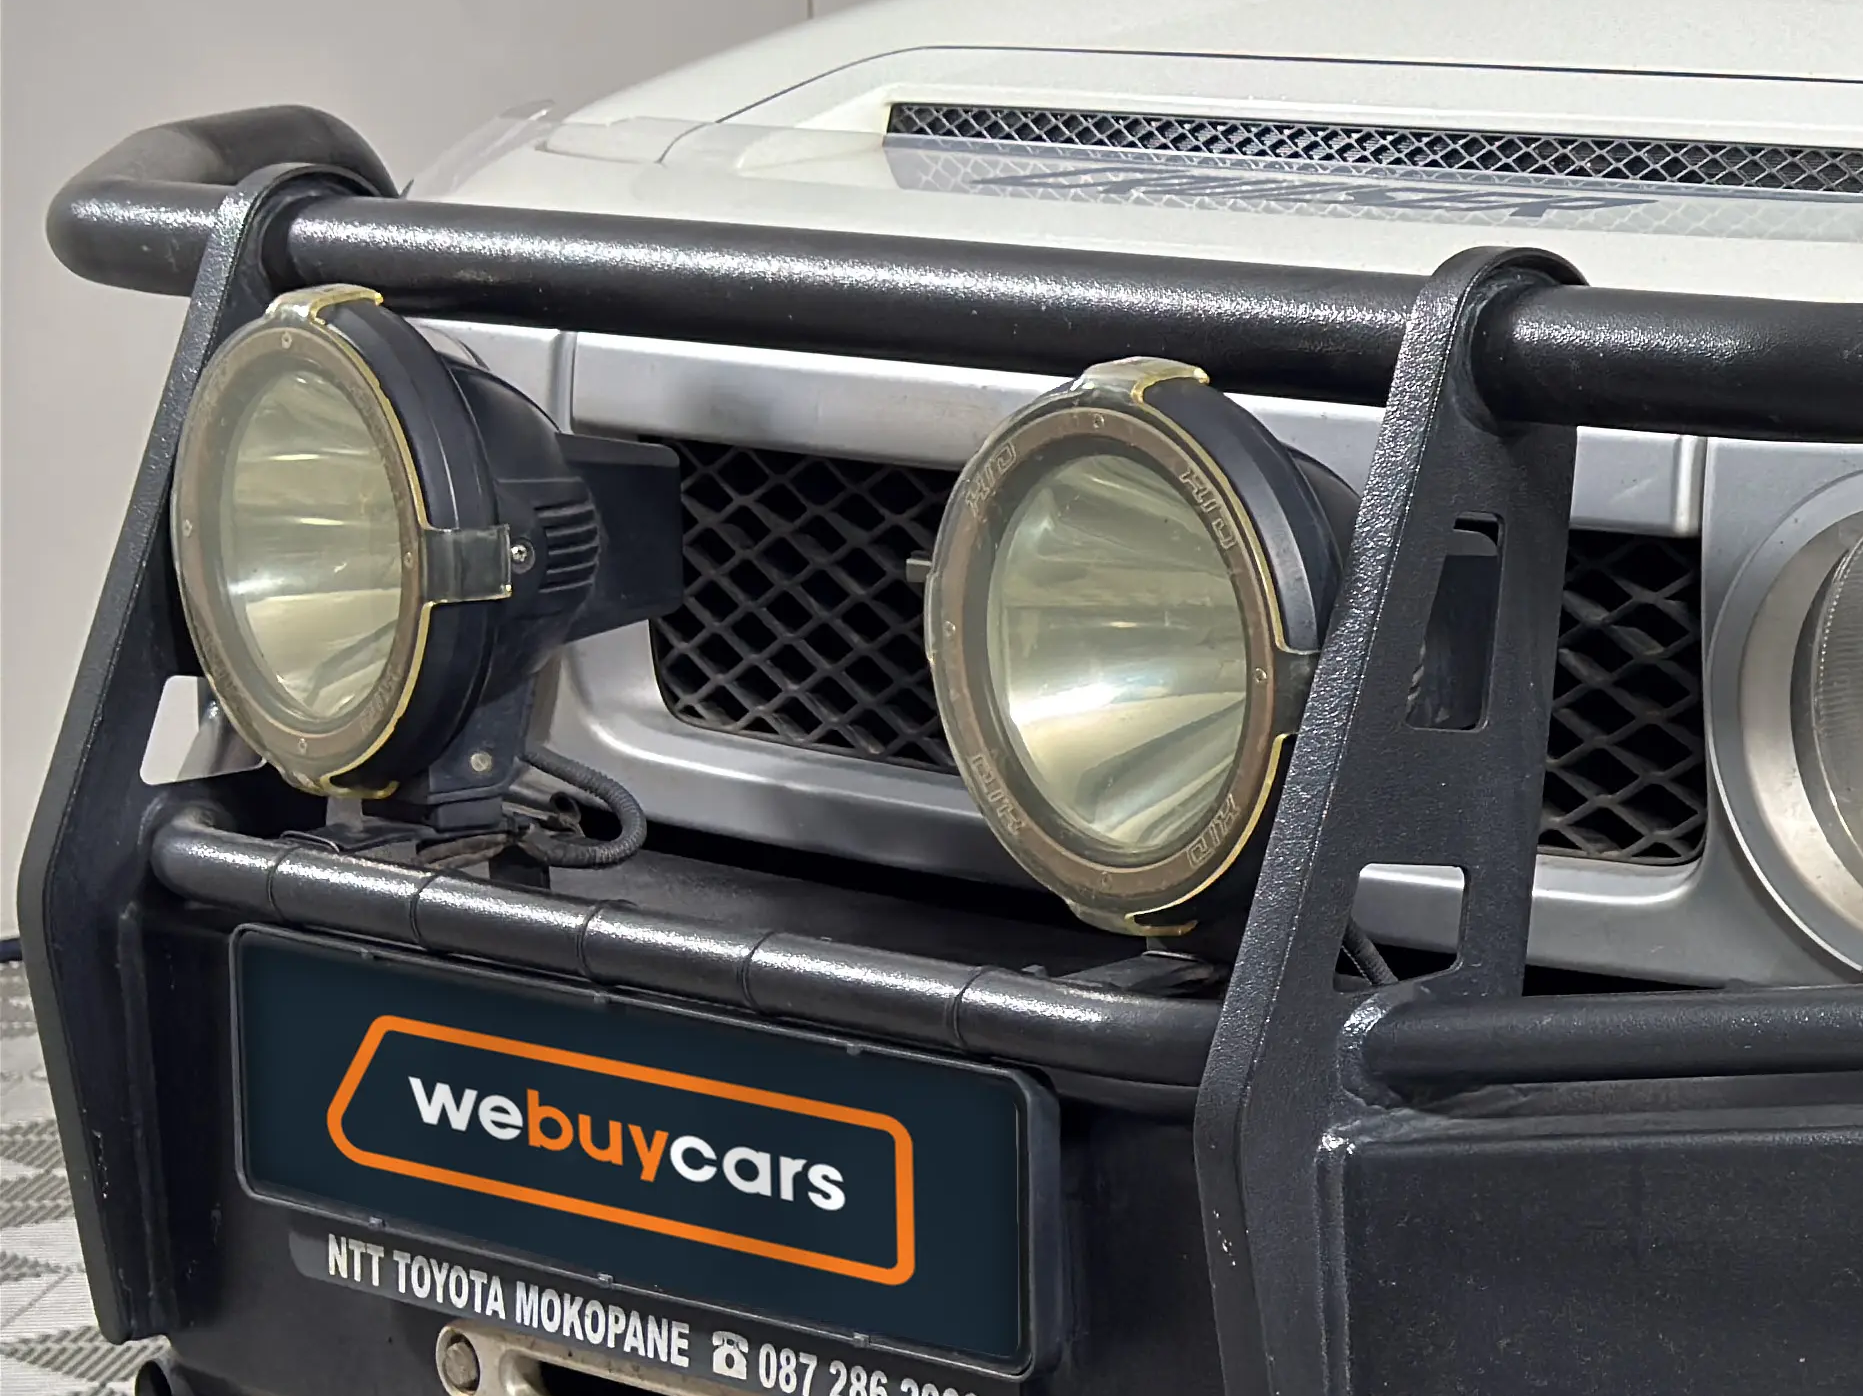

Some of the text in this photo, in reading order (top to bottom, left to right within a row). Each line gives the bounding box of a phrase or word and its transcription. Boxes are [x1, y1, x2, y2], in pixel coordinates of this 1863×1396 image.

[328, 1233, 384, 1287] NTT
[393, 1249, 506, 1320] TOYOTA
[515, 1281, 690, 1368] MOKOPANE
